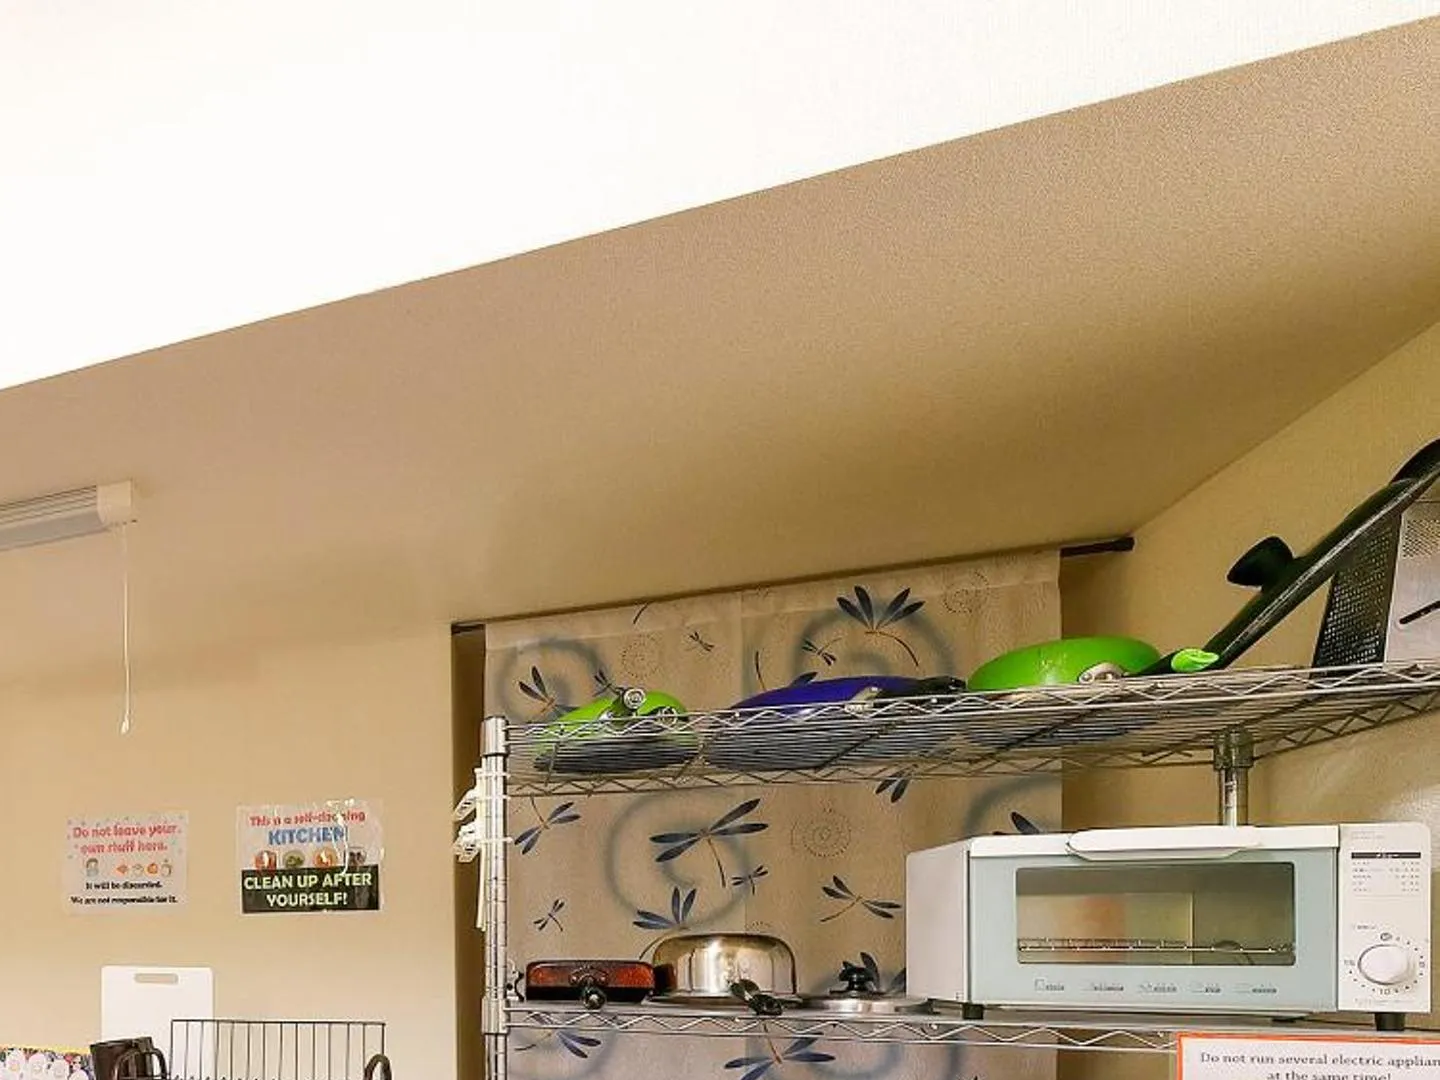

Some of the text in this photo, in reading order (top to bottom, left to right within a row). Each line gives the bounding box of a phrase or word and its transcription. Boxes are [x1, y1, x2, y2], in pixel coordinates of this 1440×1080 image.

[250, 816, 271, 826] This
[73, 824, 177, 838] Do not leave your
[268, 825, 349, 845] KITCHEN
[80, 840, 168, 854] own stuff here.
[244, 872, 372, 890] CLEAN UP AFTER
[267, 892, 348, 907] YOURSELF!
[1200, 1052, 1220, 1063] Do
[1222, 1054, 1246, 1064] not
[1249, 1055, 1275, 1065] run
[1278, 1054, 1328, 1065] several
[1331, 1053, 1383, 1066] electric
[1266, 1071, 1281, 1080] at
[1285, 1069, 1309, 1080] the
